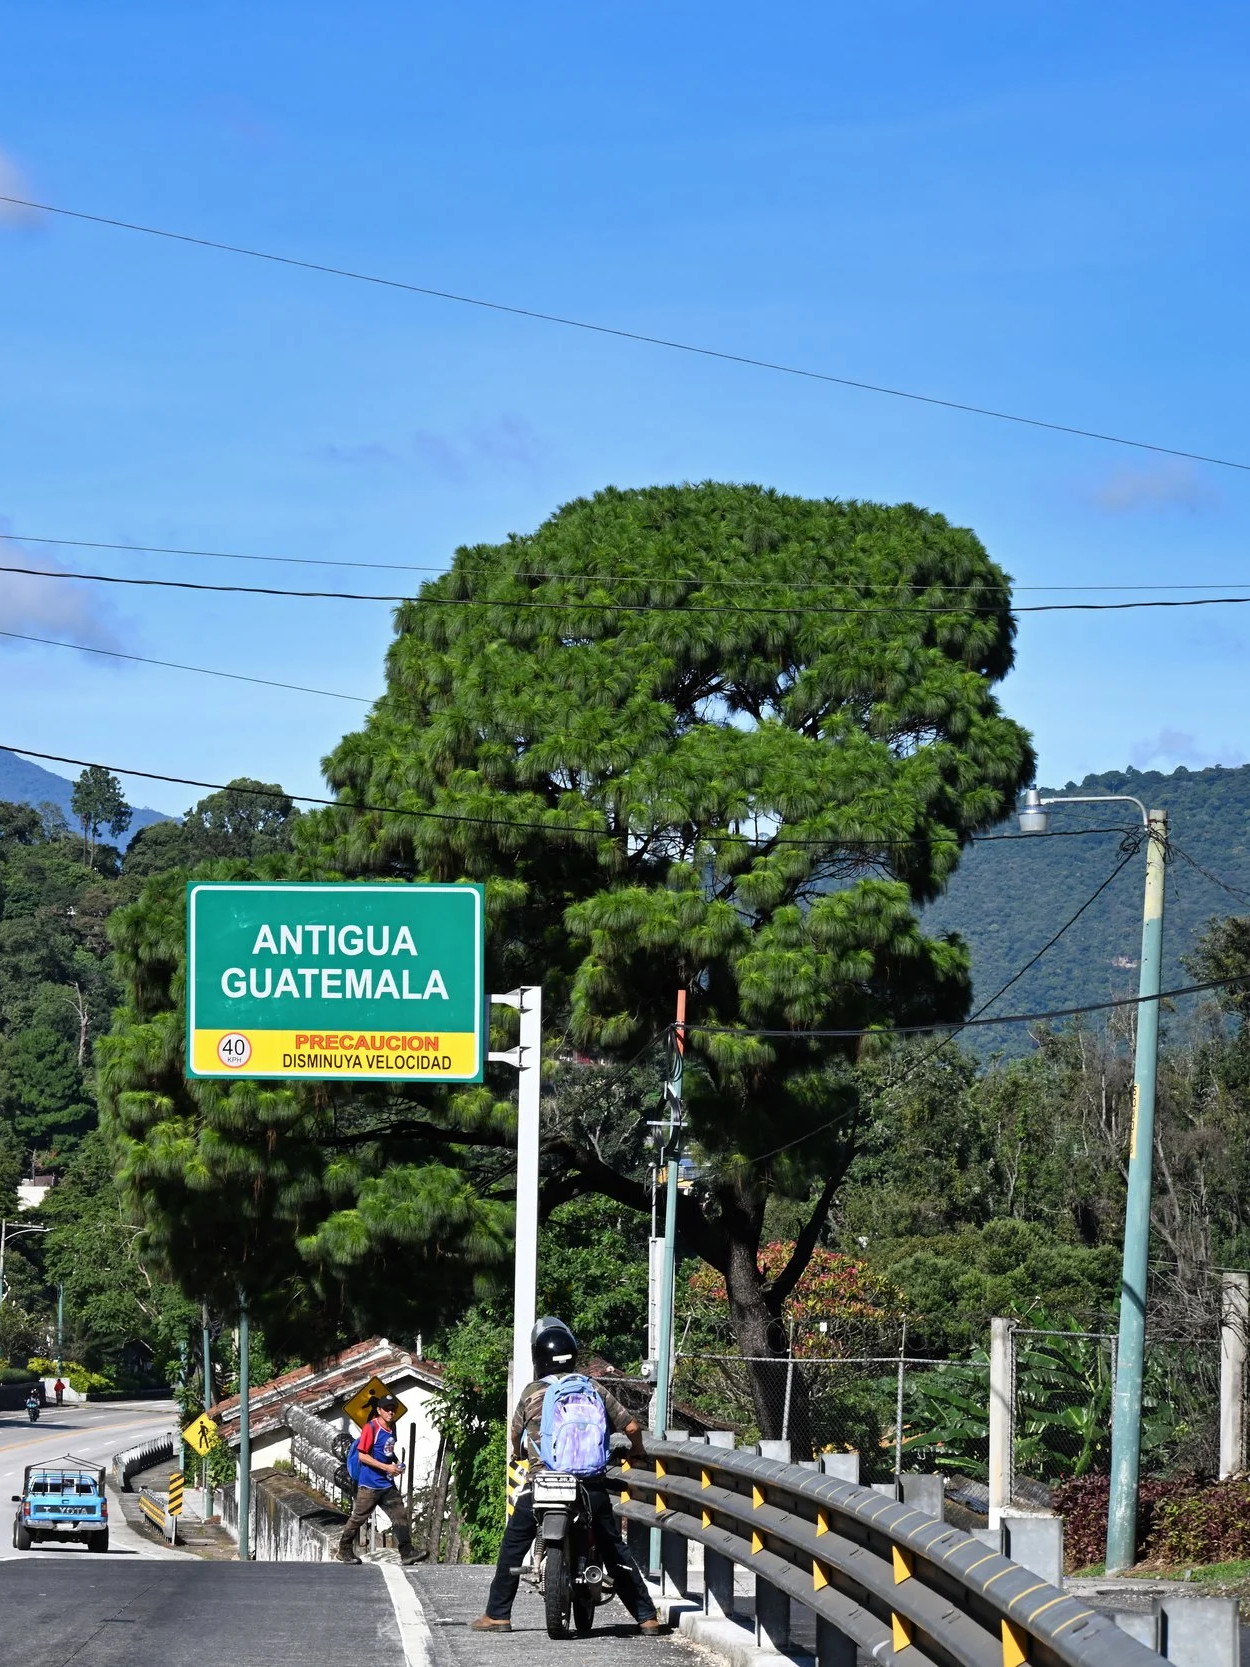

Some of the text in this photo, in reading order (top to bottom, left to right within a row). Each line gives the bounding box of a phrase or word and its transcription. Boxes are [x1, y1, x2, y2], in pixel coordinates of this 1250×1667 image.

[252, 924, 418, 956] ANTIGUA
[220, 967, 450, 1000] GUATEMALA
[222, 1039, 245, 1056] 40
[295, 1034, 440, 1052] PRECAUCION
[283, 1053, 452, 1070] DISMINUYA VELOCIDAD
[43, 1506, 88, 1515] TYOTA
